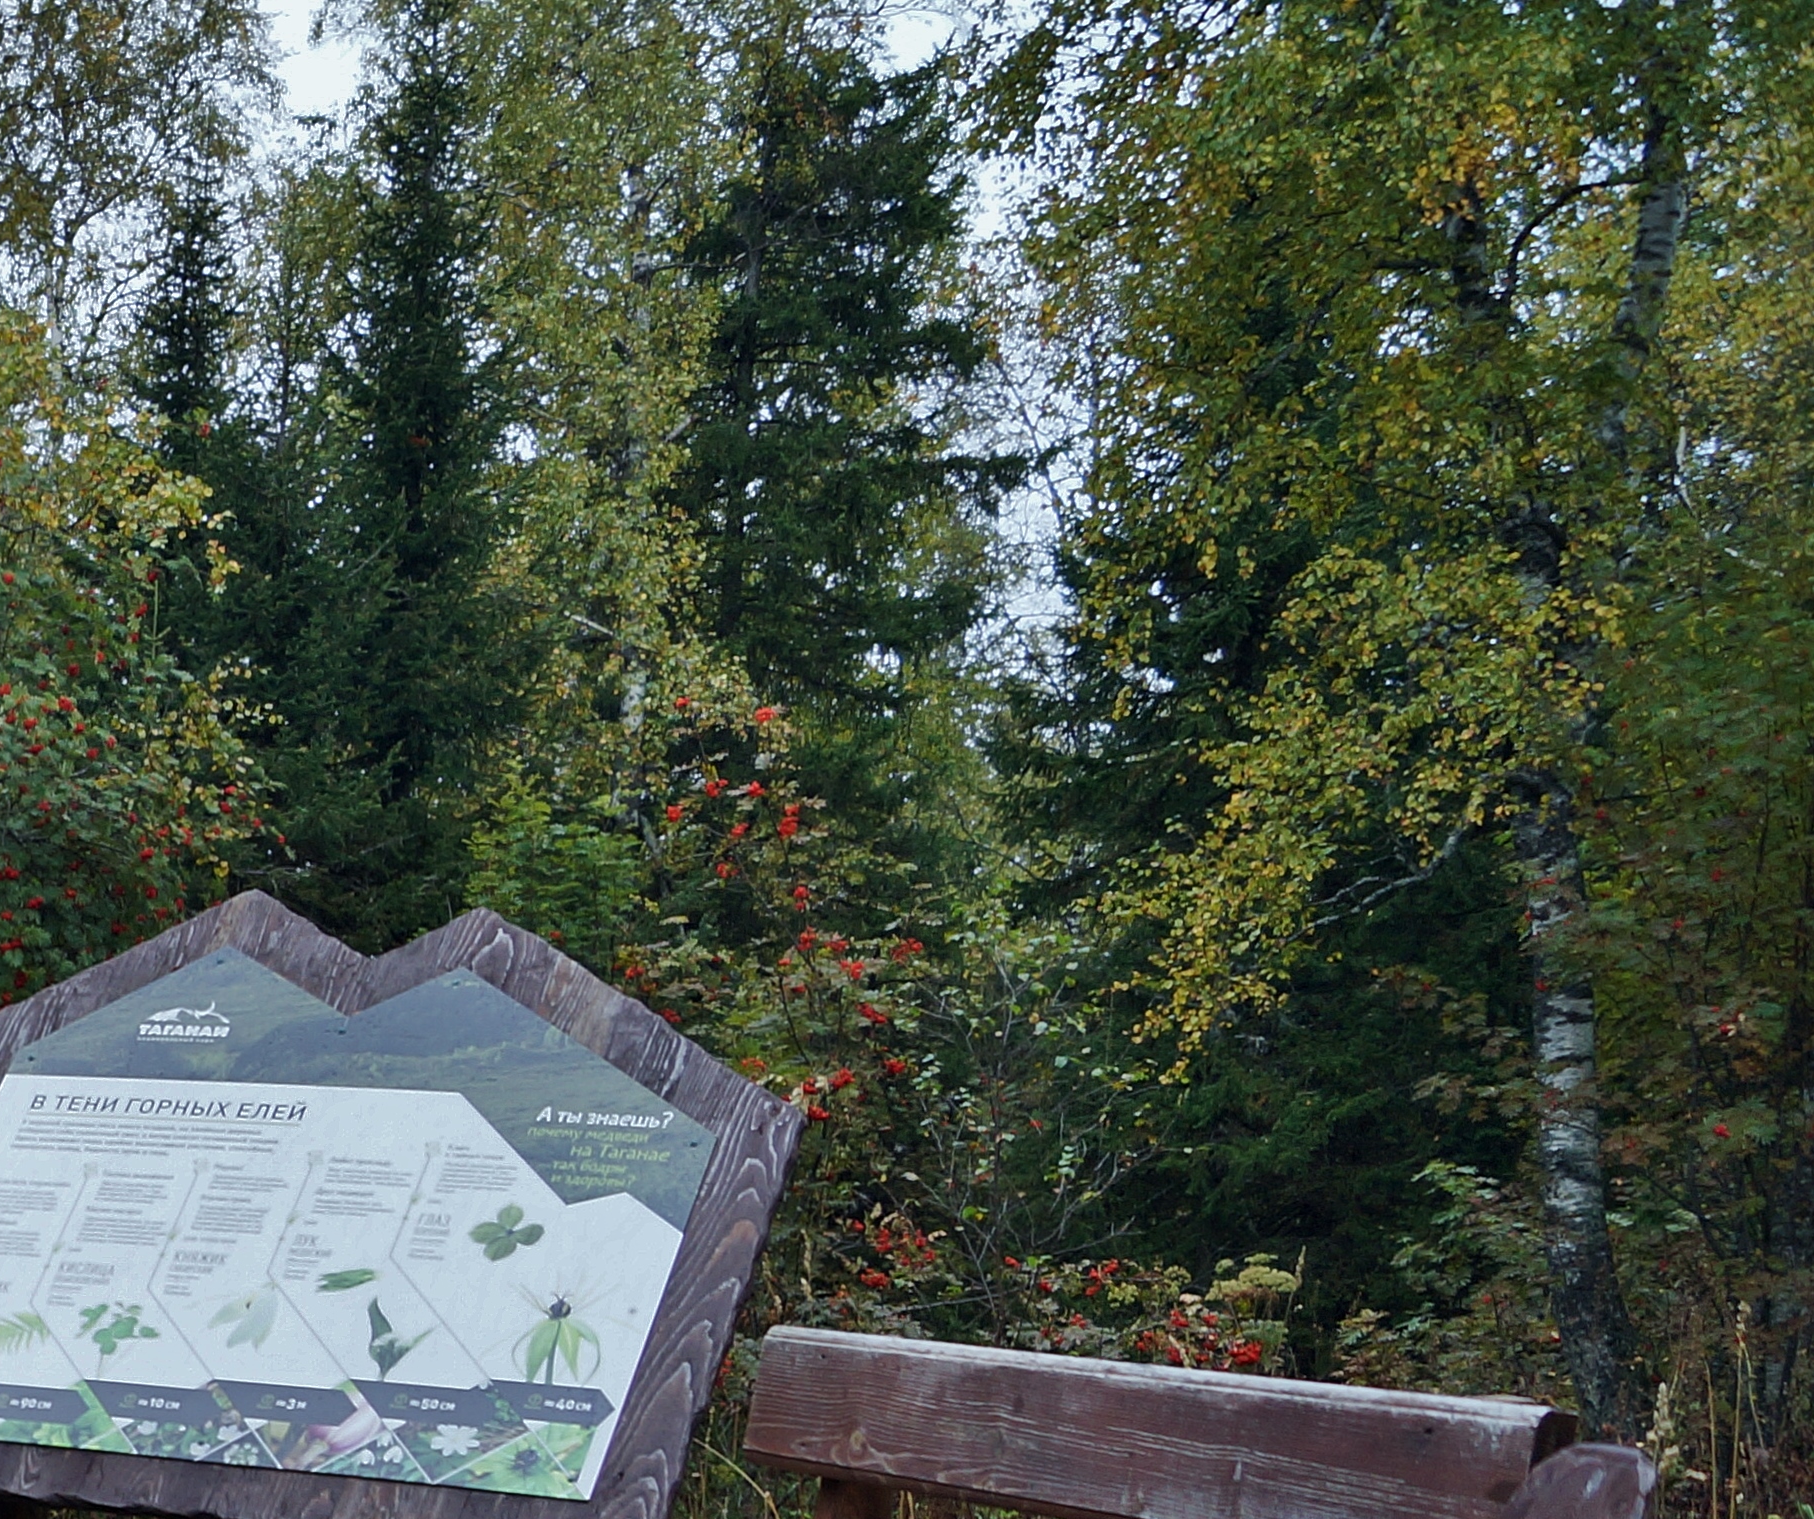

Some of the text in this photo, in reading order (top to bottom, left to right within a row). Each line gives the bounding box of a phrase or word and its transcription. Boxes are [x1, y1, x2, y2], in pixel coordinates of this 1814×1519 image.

[30, 1094, 308, 1122] В ТЕНИ ГОРНЫХ ЕЛЕЙ
[536, 1105, 675, 1129] А ты знаешь?
[527, 1126, 650, 1144] почему медведи
[570, 1143, 671, 1163] на Таганае
[552, 1159, 576, 1171] так
